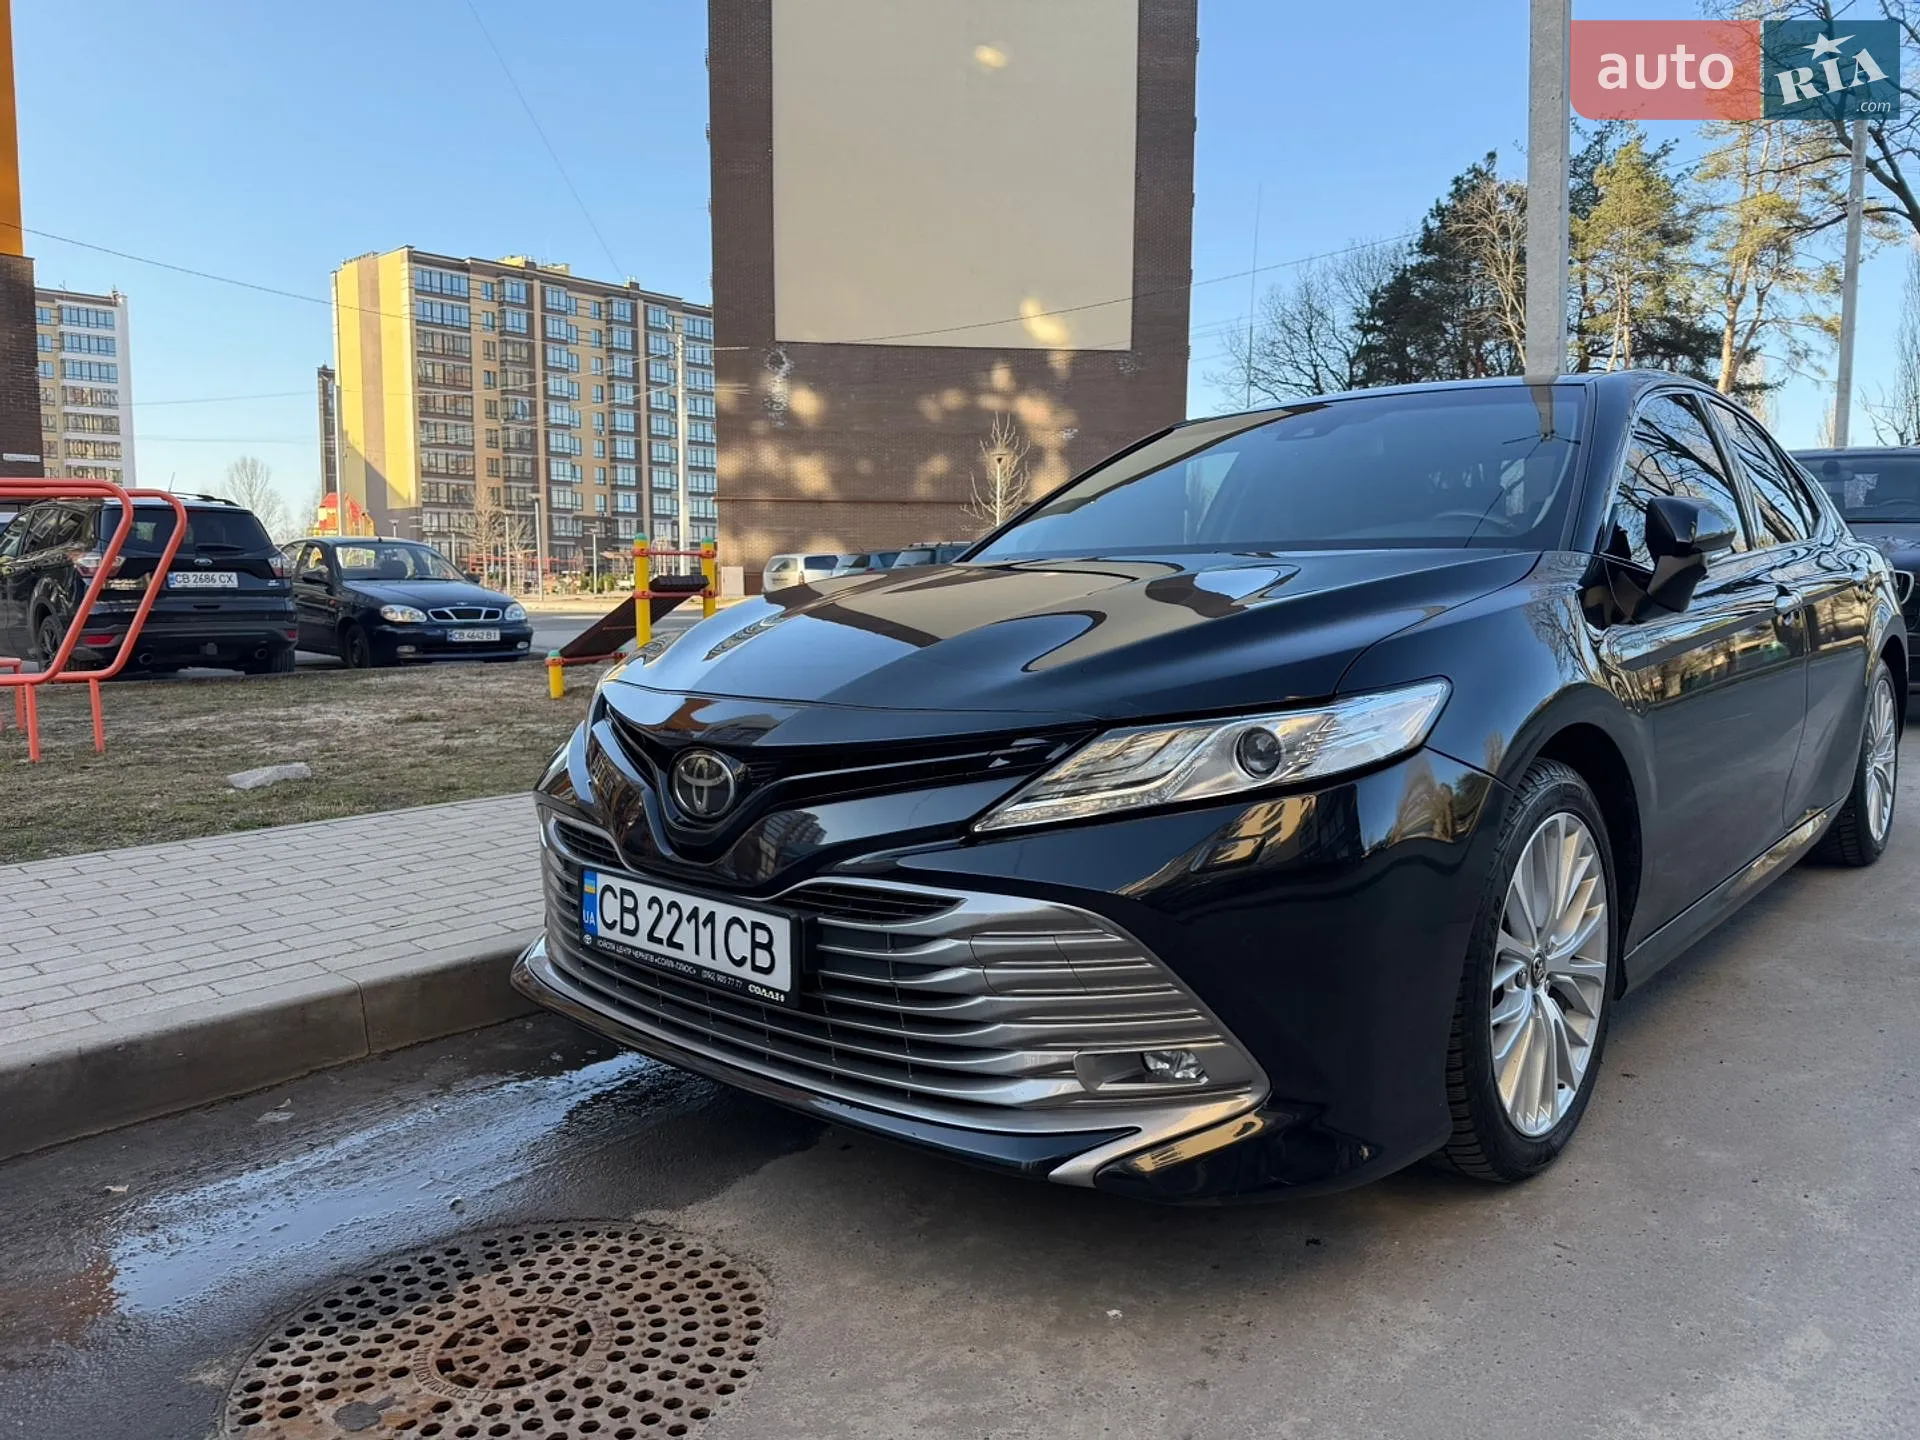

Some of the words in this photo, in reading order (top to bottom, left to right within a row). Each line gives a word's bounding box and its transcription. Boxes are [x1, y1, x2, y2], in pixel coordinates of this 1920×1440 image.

[582, 909, 596, 927] UA
[599, 884, 640, 937] CB
[646, 895, 717, 961] 2211
[724, 916, 776, 976] CB
